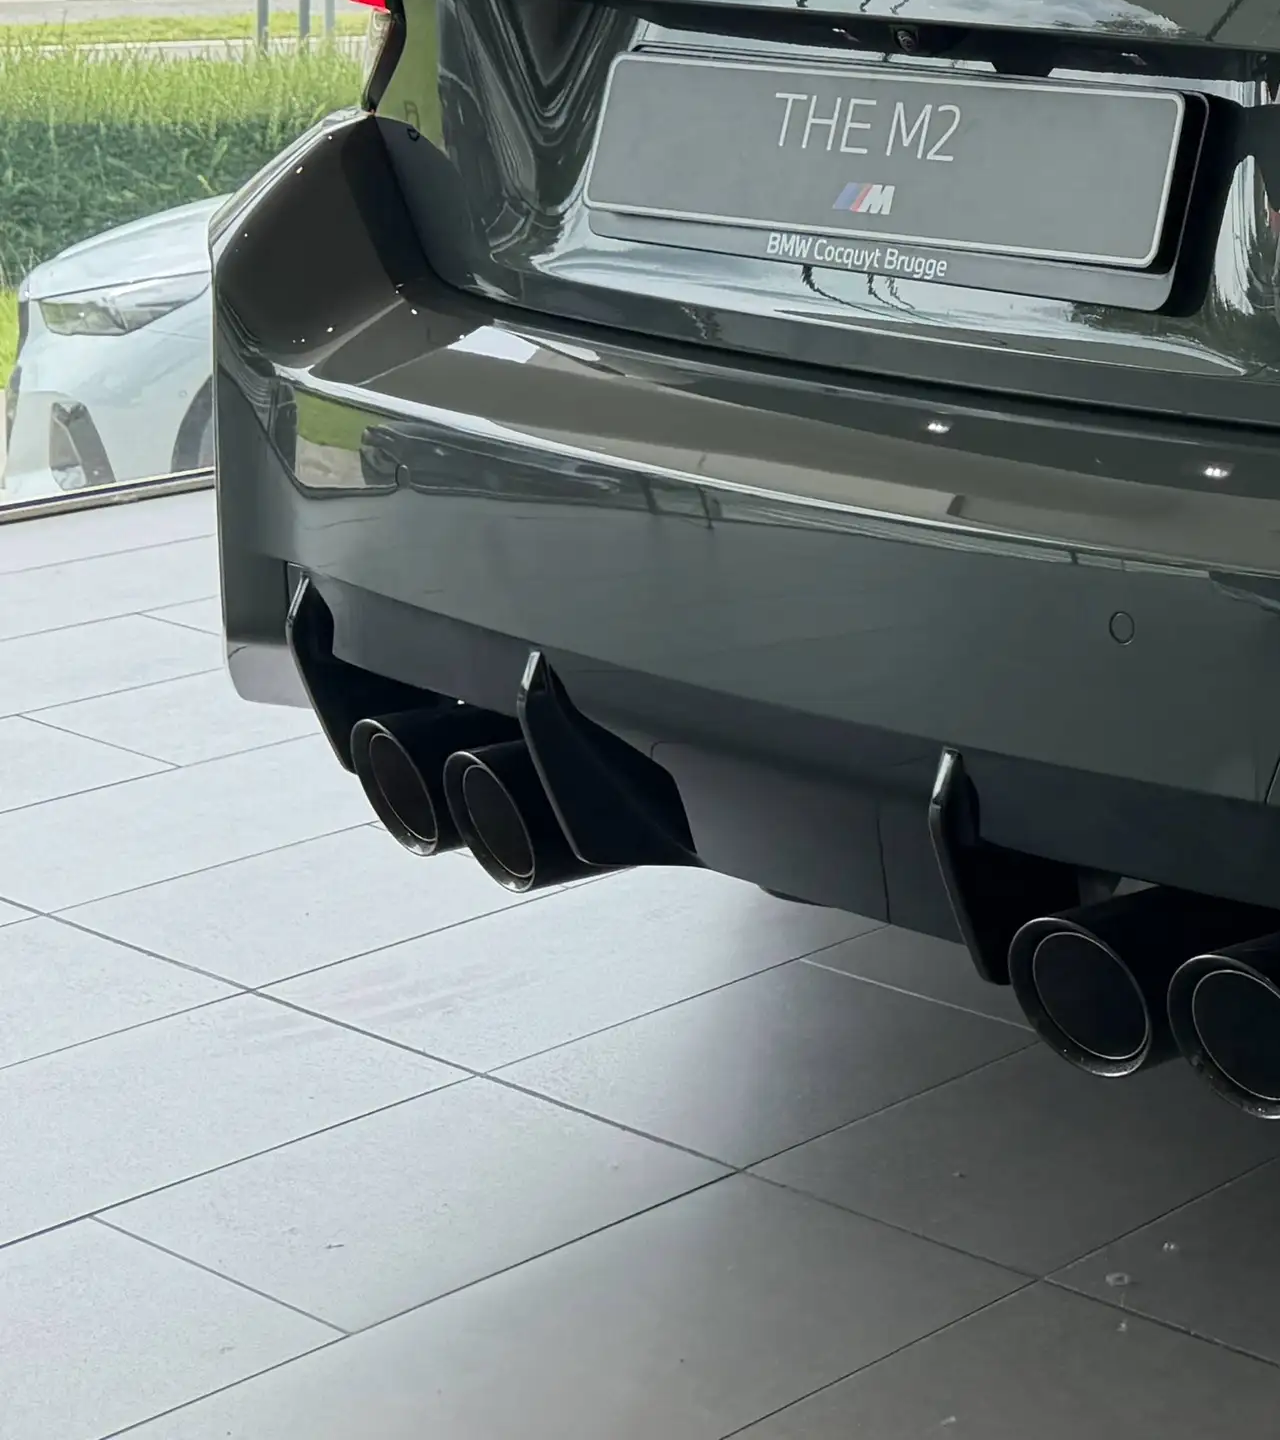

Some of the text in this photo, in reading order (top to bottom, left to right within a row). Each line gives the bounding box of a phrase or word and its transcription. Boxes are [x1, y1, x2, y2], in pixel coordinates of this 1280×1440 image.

[775, 92, 963, 162] THE M2
[766, 231, 949, 279] BMW Cocquyt Brugge
